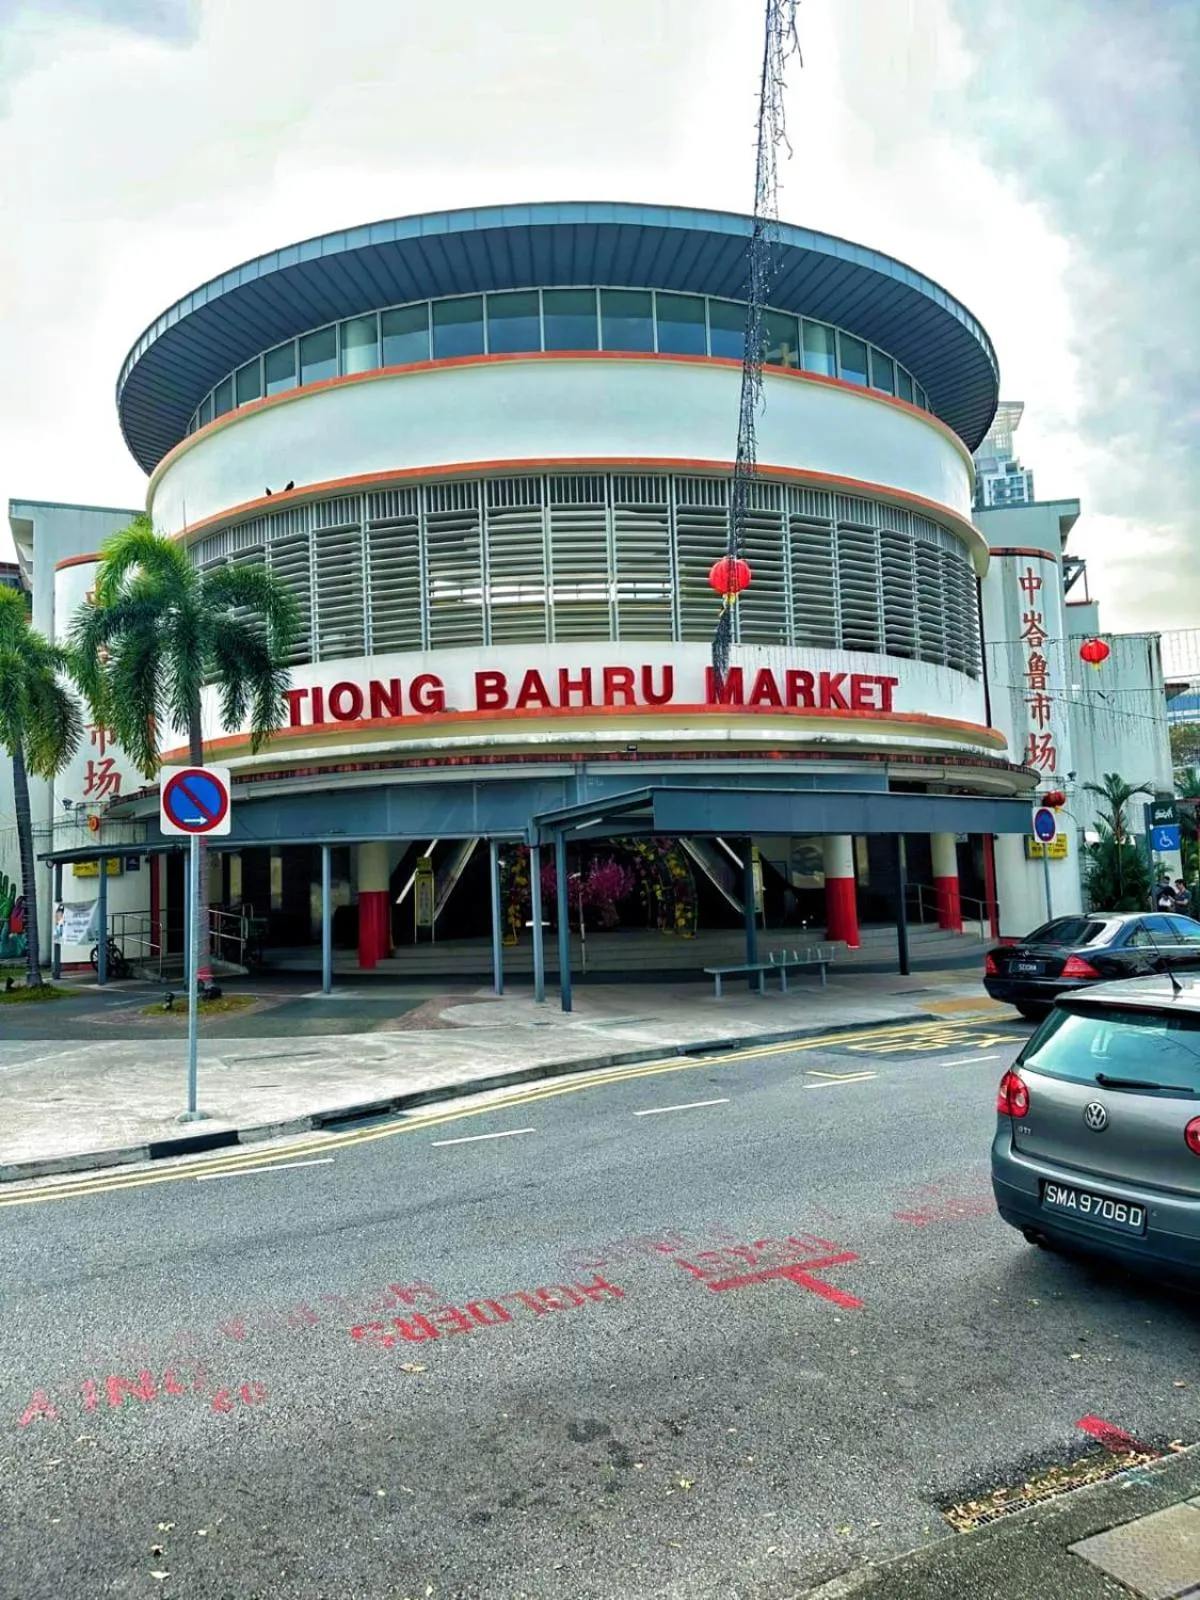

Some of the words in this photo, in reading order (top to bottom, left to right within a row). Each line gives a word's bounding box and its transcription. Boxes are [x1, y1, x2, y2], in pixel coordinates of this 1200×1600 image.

[283, 673, 446, 727] TIONG
[474, 664, 674, 712] BAHRU
[704, 665, 899, 714] MARKET
[1018, 566, 1057, 773] 中峇鲁市场
